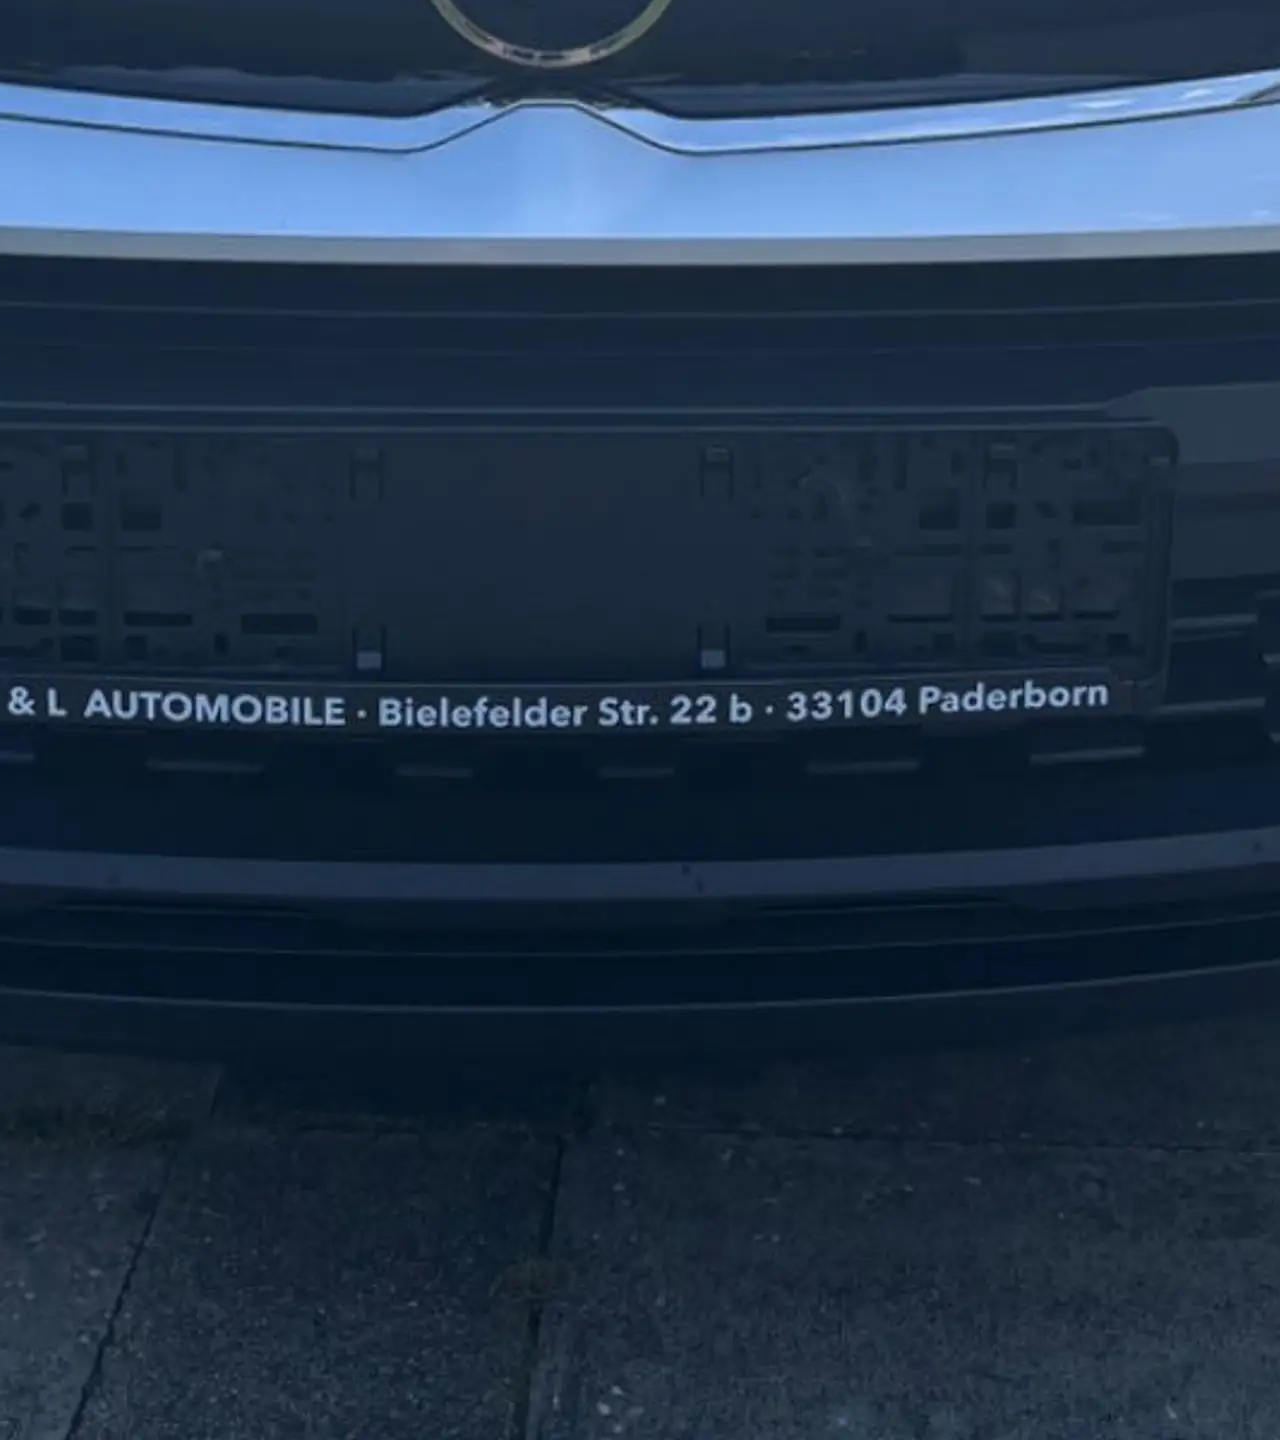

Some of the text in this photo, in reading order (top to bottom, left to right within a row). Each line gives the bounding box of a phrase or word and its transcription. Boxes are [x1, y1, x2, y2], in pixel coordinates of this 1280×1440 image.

[7, 685, 35, 716] &
[47, 688, 67, 717] L
[83, 688, 346, 726] AUTOMOBILE
[379, 696, 589, 727] Bielefelder
[598, 696, 658, 727] Str.
[670, 694, 717, 724] 22
[730, 693, 753, 723] b
[786, 687, 908, 722] 33104
[919, 680, 1108, 714] Paderborn
